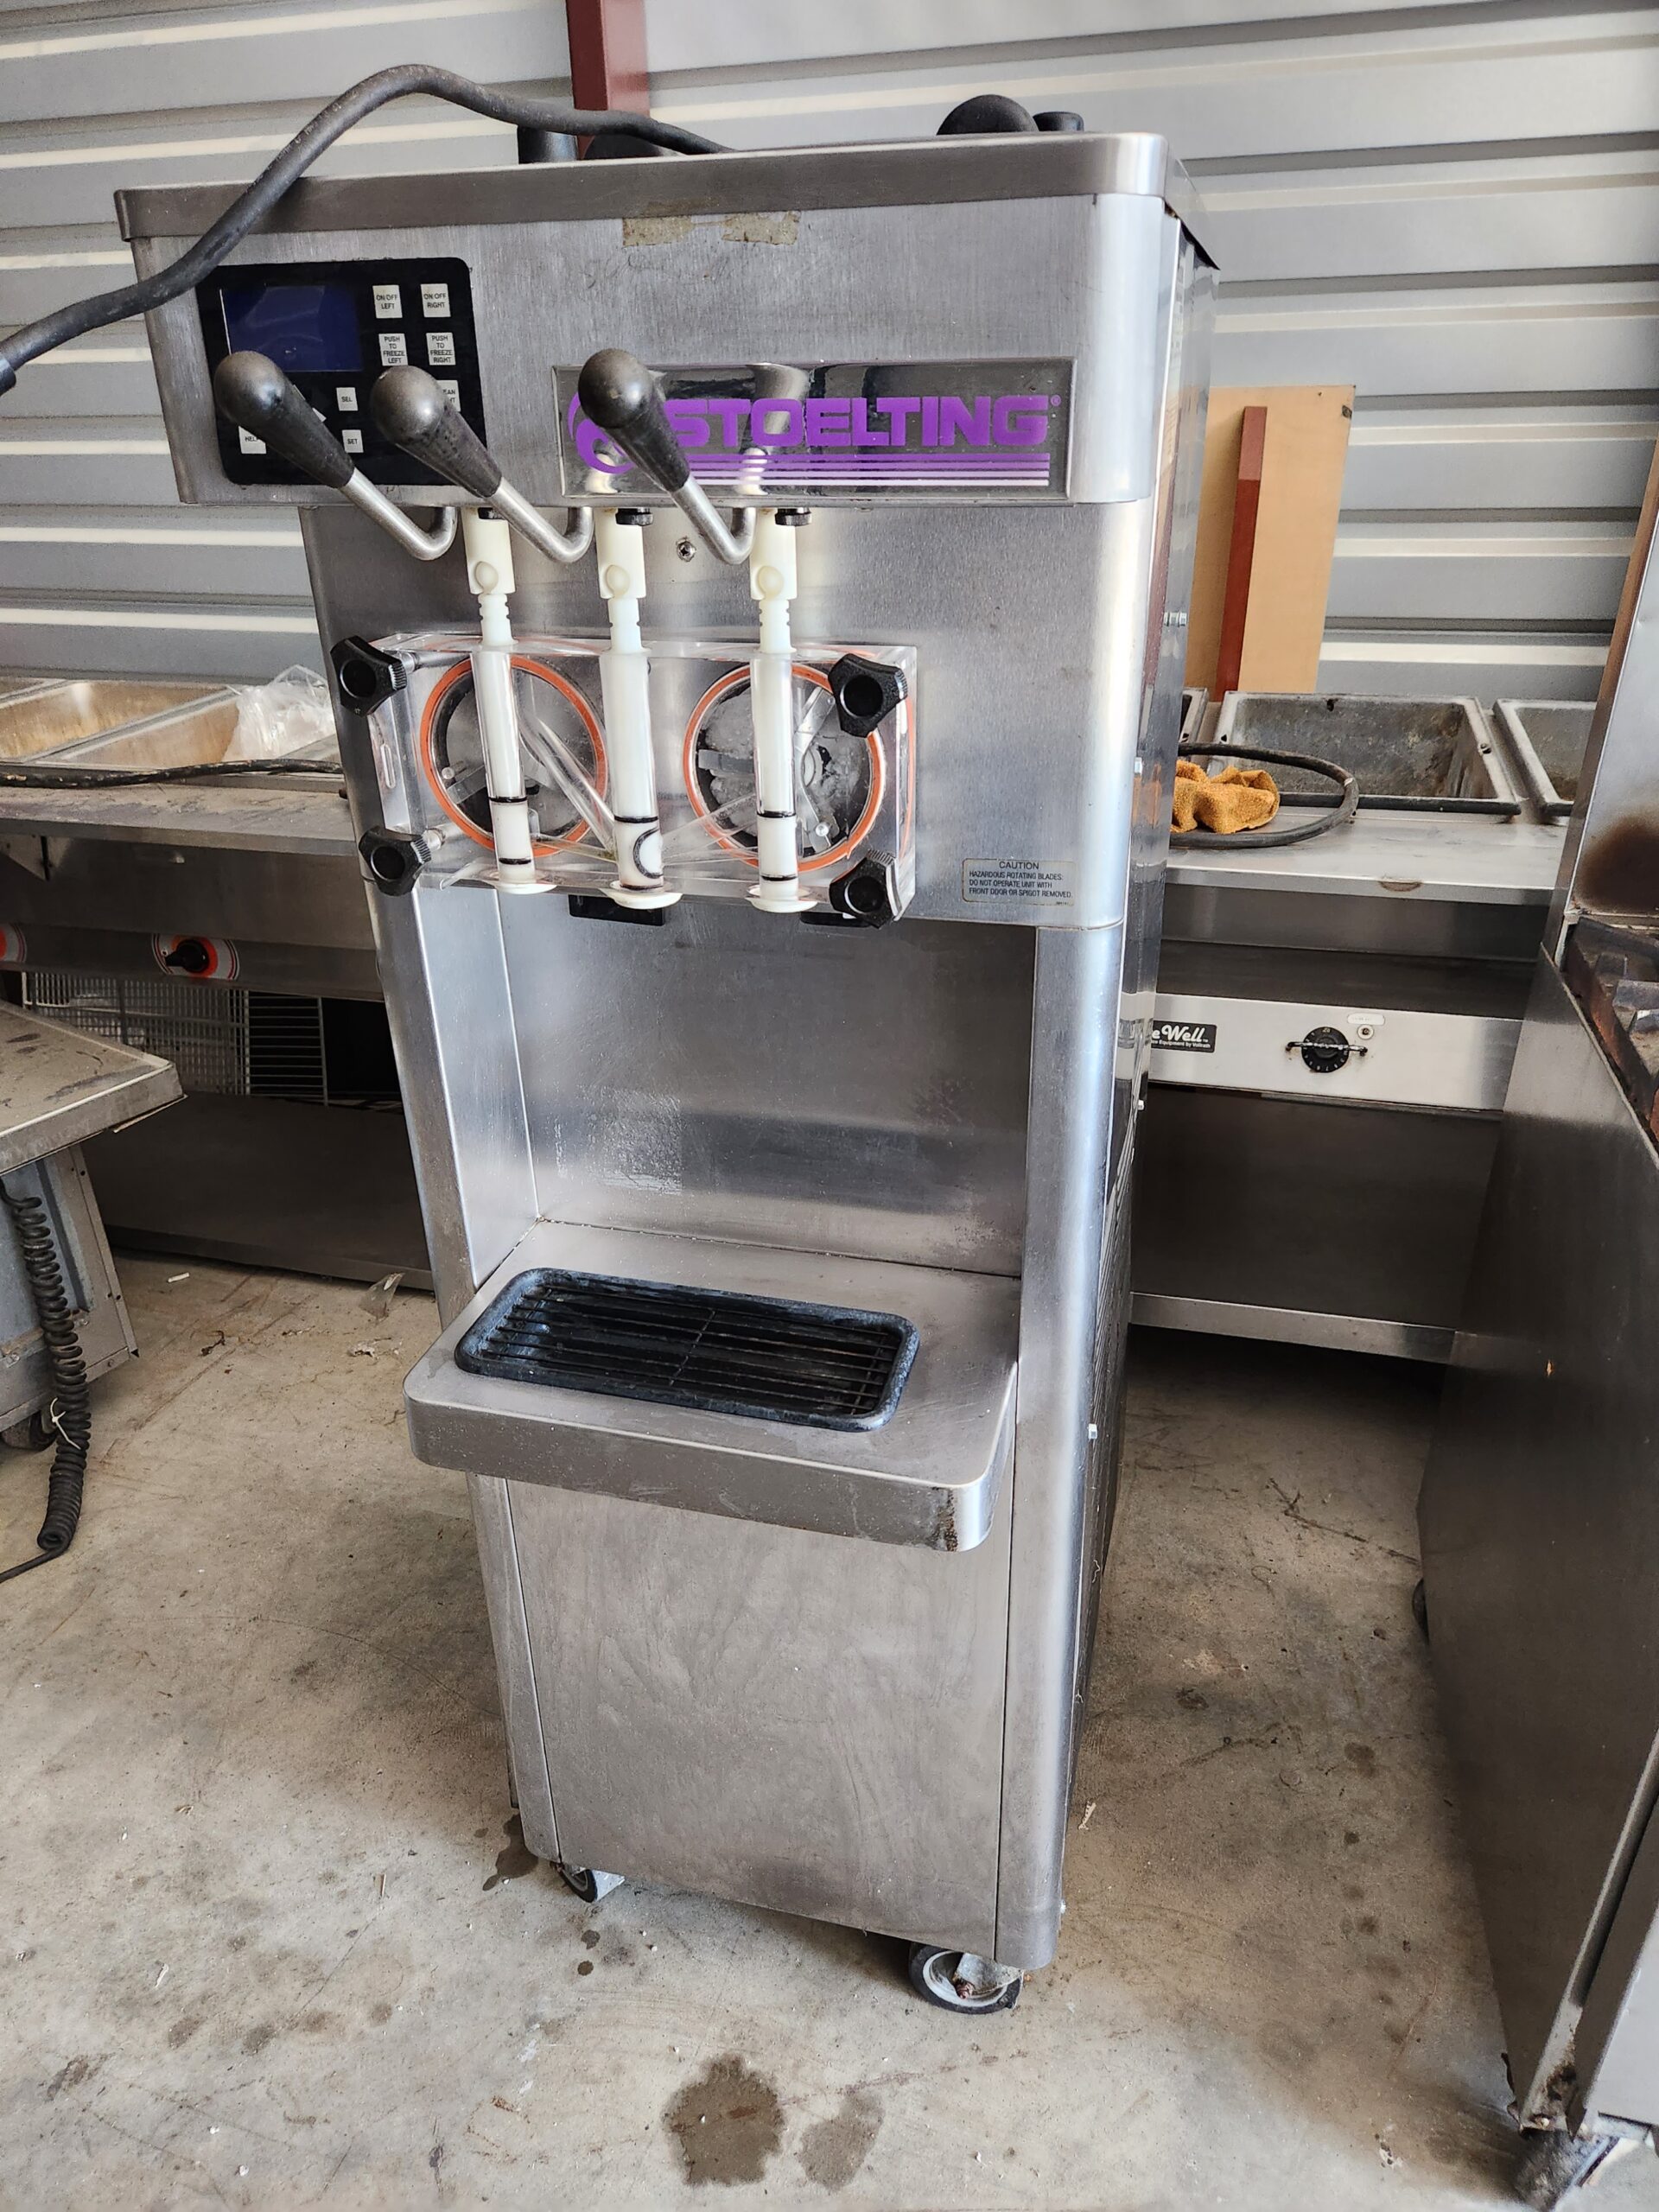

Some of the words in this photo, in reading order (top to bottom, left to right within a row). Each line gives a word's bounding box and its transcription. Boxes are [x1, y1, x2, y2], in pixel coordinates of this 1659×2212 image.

[664, 395, 1050, 448] STOELTING
[999, 861, 1039, 869] CAUTION
[1007, 871, 1037, 880] ROTATING
[993, 880, 1020, 888] OPERATE
